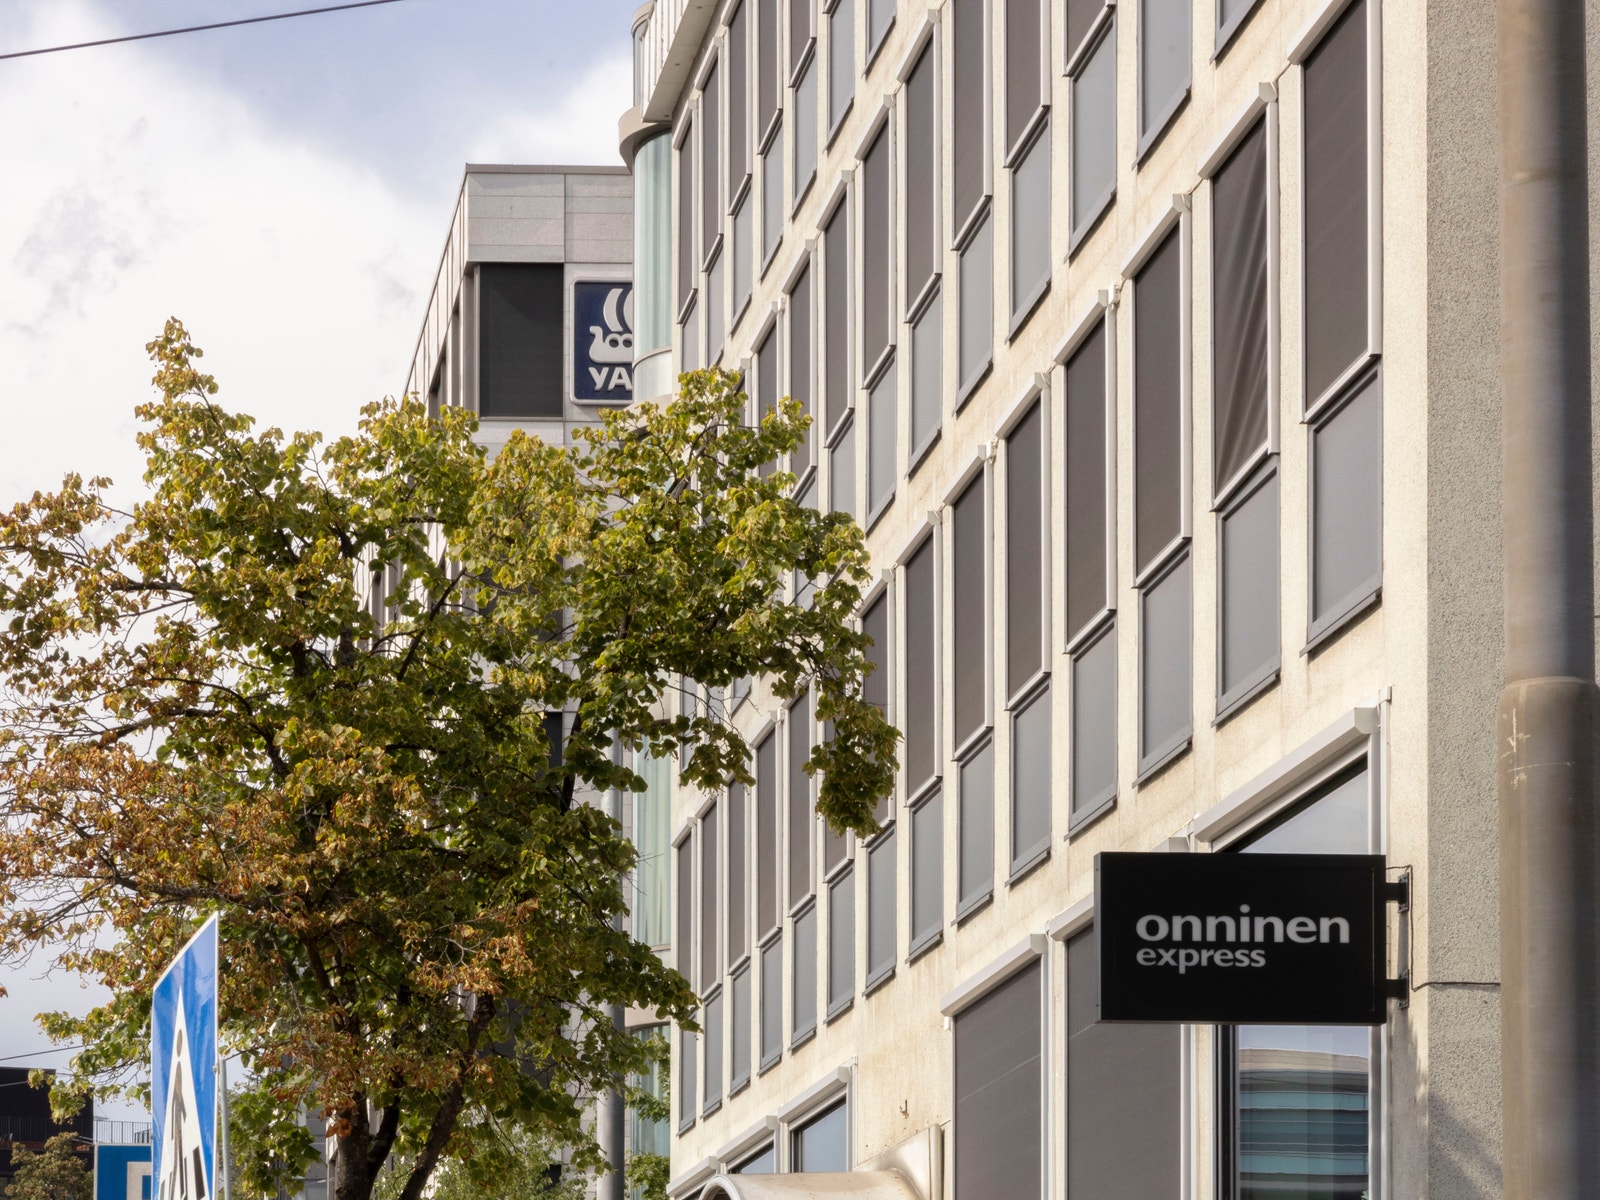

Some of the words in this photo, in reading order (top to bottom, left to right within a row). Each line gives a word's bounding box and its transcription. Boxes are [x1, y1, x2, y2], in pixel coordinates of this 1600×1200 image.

[588, 367, 633, 391] YA
[1136, 904, 1350, 943] onninen
[1136, 948, 1266, 974] express
